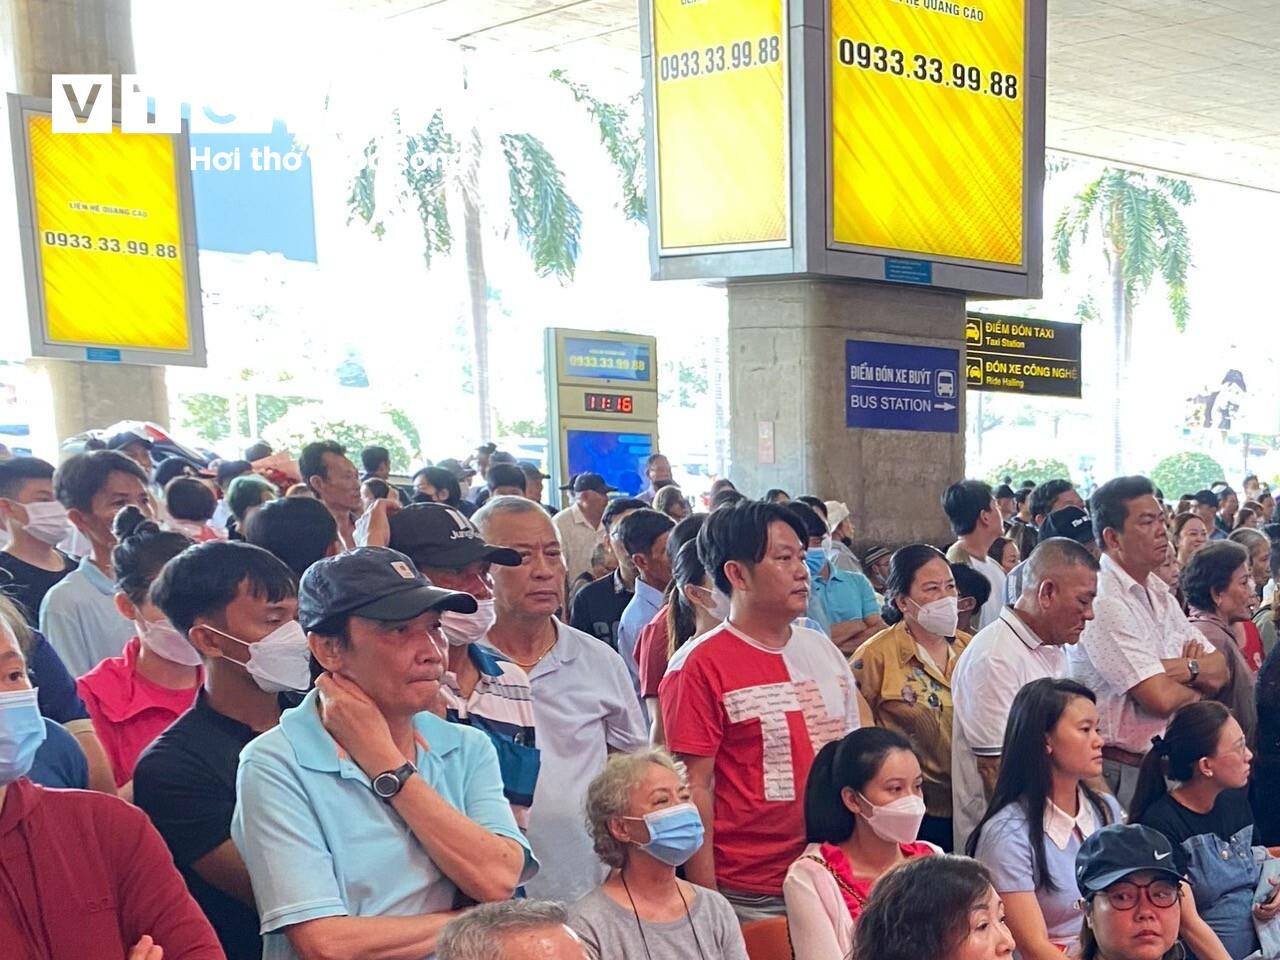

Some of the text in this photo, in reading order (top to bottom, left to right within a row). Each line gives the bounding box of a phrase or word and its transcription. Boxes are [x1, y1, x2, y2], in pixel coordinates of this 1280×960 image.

[660, 35, 780, 81] 0933.33.99.88
[838, 38, 1018, 100] 0933.33.99.88
[45, 231, 177, 259] 0933.33.99.88
[1034, 327, 1055, 339] TAXI
[985, 337, 1025, 349] Taxi Station
[850, 362, 931, 385] ĐIỂM ĐÓN XE BUÝT
[985, 360, 1007, 374] ĐÓN
[1009, 364, 1022, 375] XE
[1023, 363, 1051, 378] CÔNG
[590, 396, 632, 412] 11:16
[850, 395, 931, 412] BUS STATION
